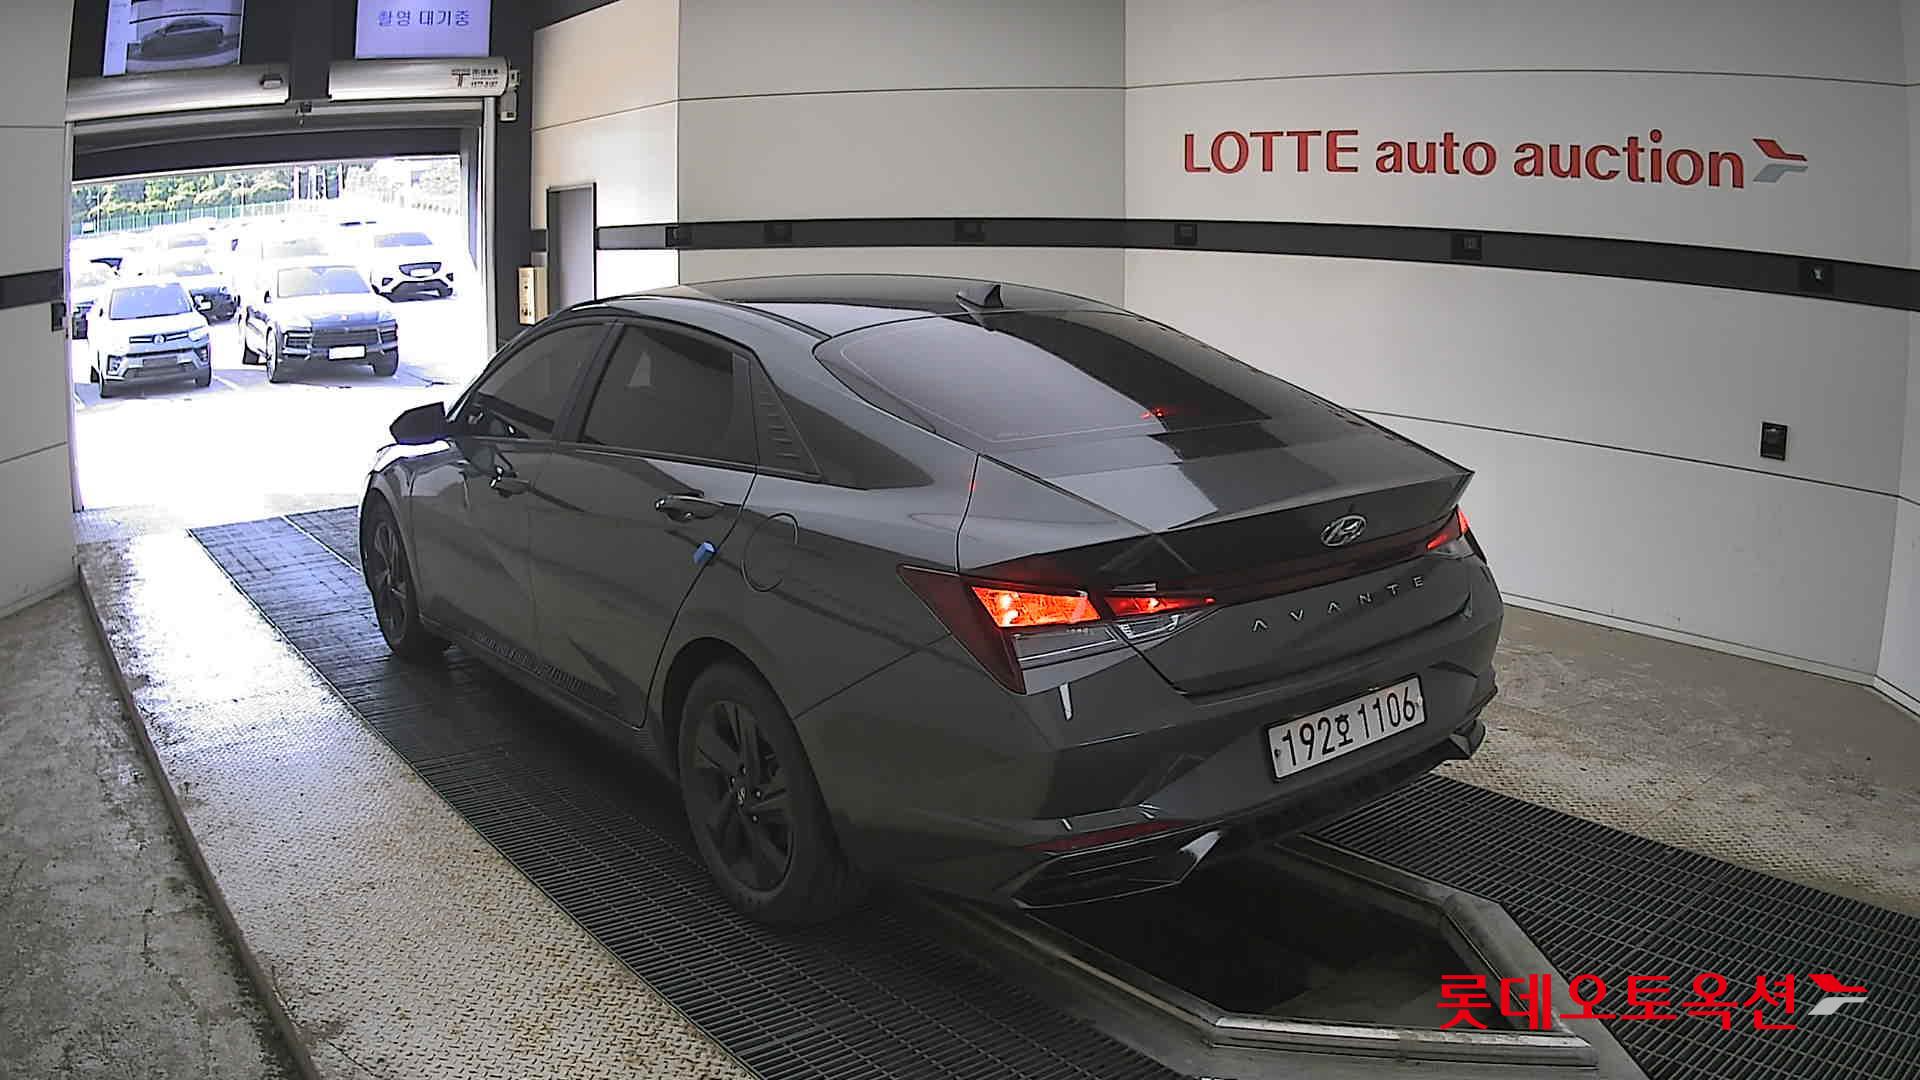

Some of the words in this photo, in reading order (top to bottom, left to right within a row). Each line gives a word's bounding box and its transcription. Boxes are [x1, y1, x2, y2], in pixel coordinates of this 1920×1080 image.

[419, 9, 470, 27] 대기중
[1183, 129, 1359, 174] LOTTE
[1374, 131, 1498, 176] auto
[1513, 128, 1745, 190] auction
[1252, 575, 1425, 633] AVANTE
